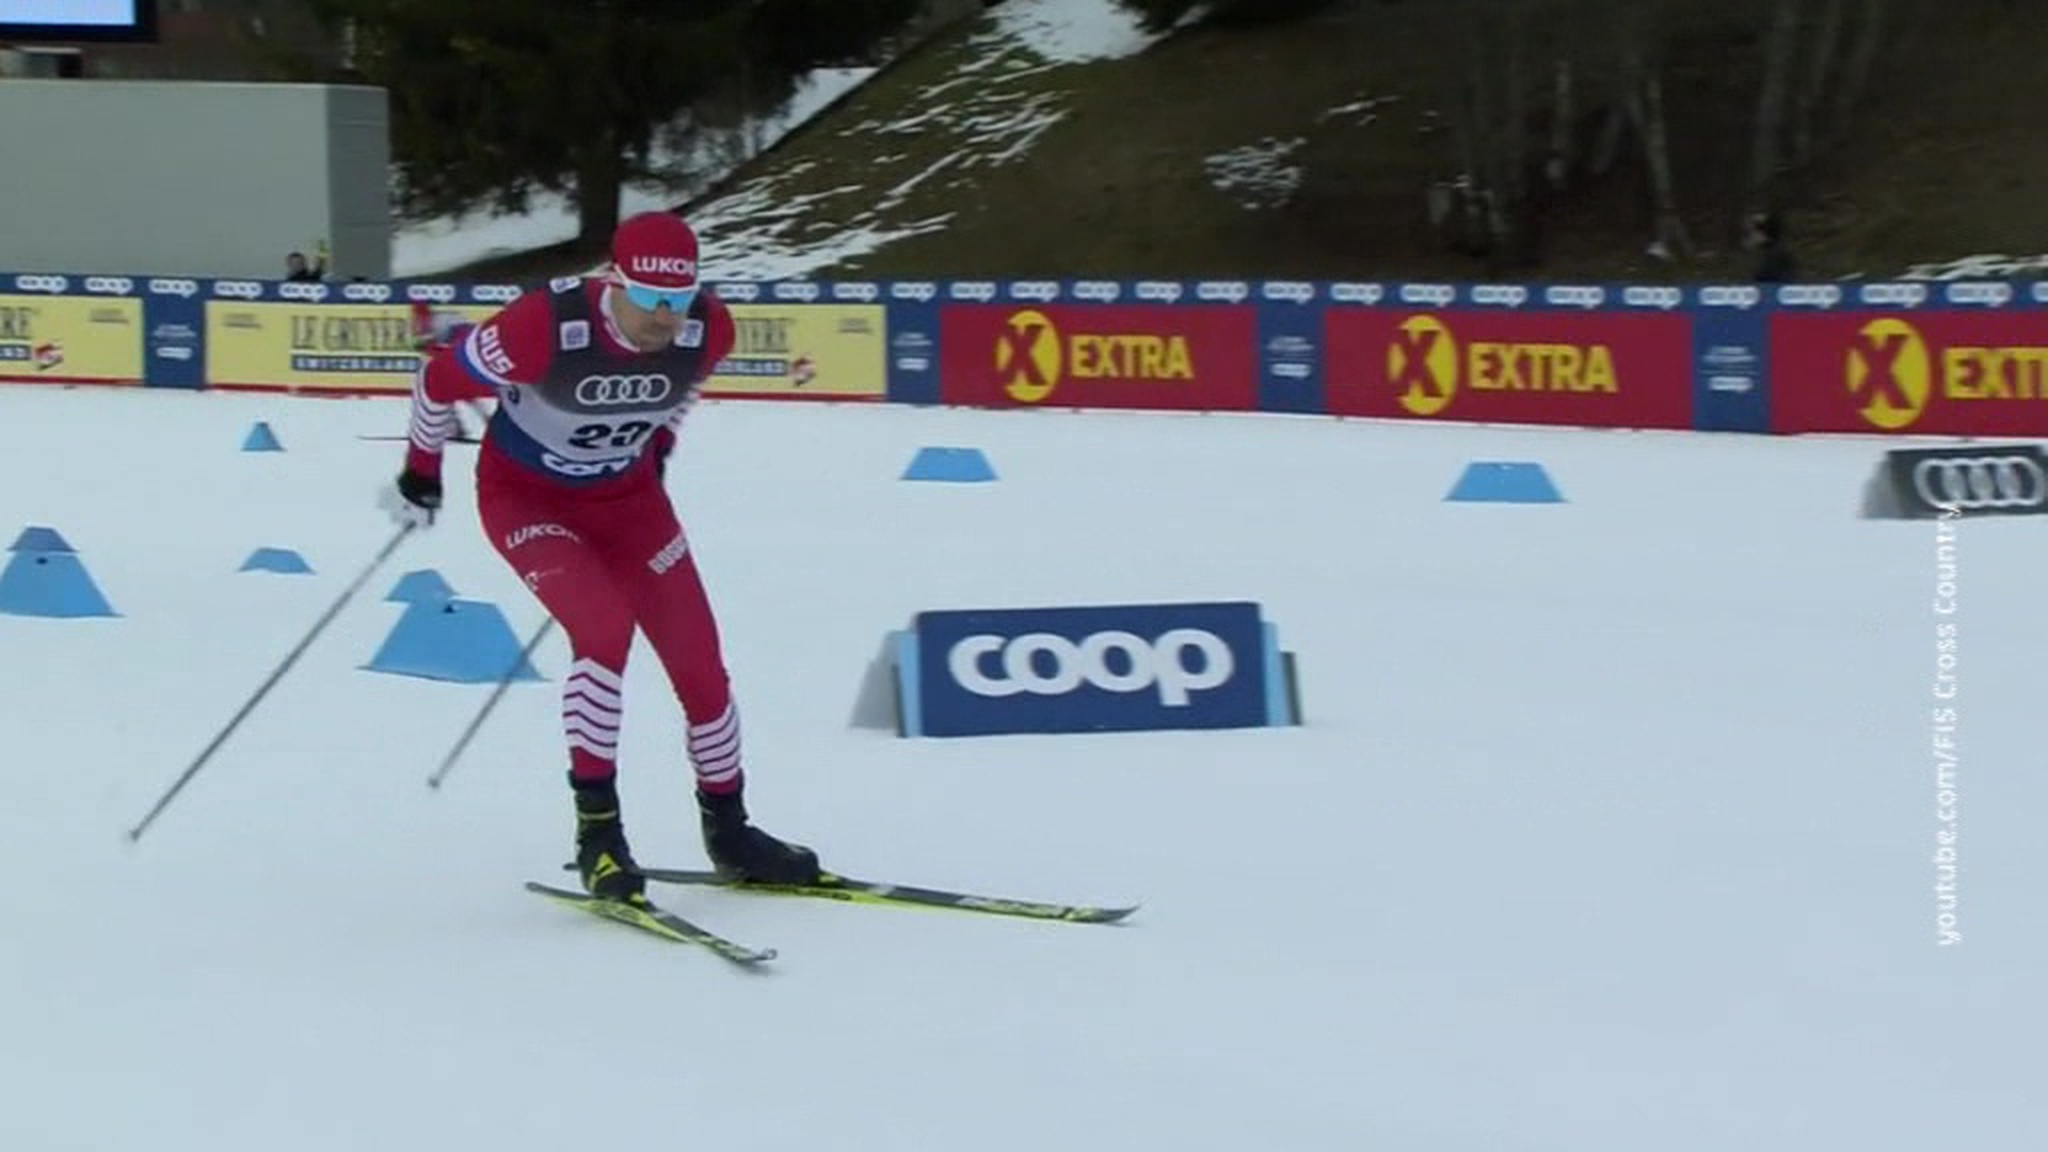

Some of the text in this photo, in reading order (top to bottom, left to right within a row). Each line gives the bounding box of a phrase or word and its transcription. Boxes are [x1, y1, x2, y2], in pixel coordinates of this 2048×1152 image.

[480, 324, 515, 374] RUS
[1070, 334, 1195, 379] EXTRA
[1469, 341, 1618, 393] EXTRA
[948, 628, 1234, 706] coop
